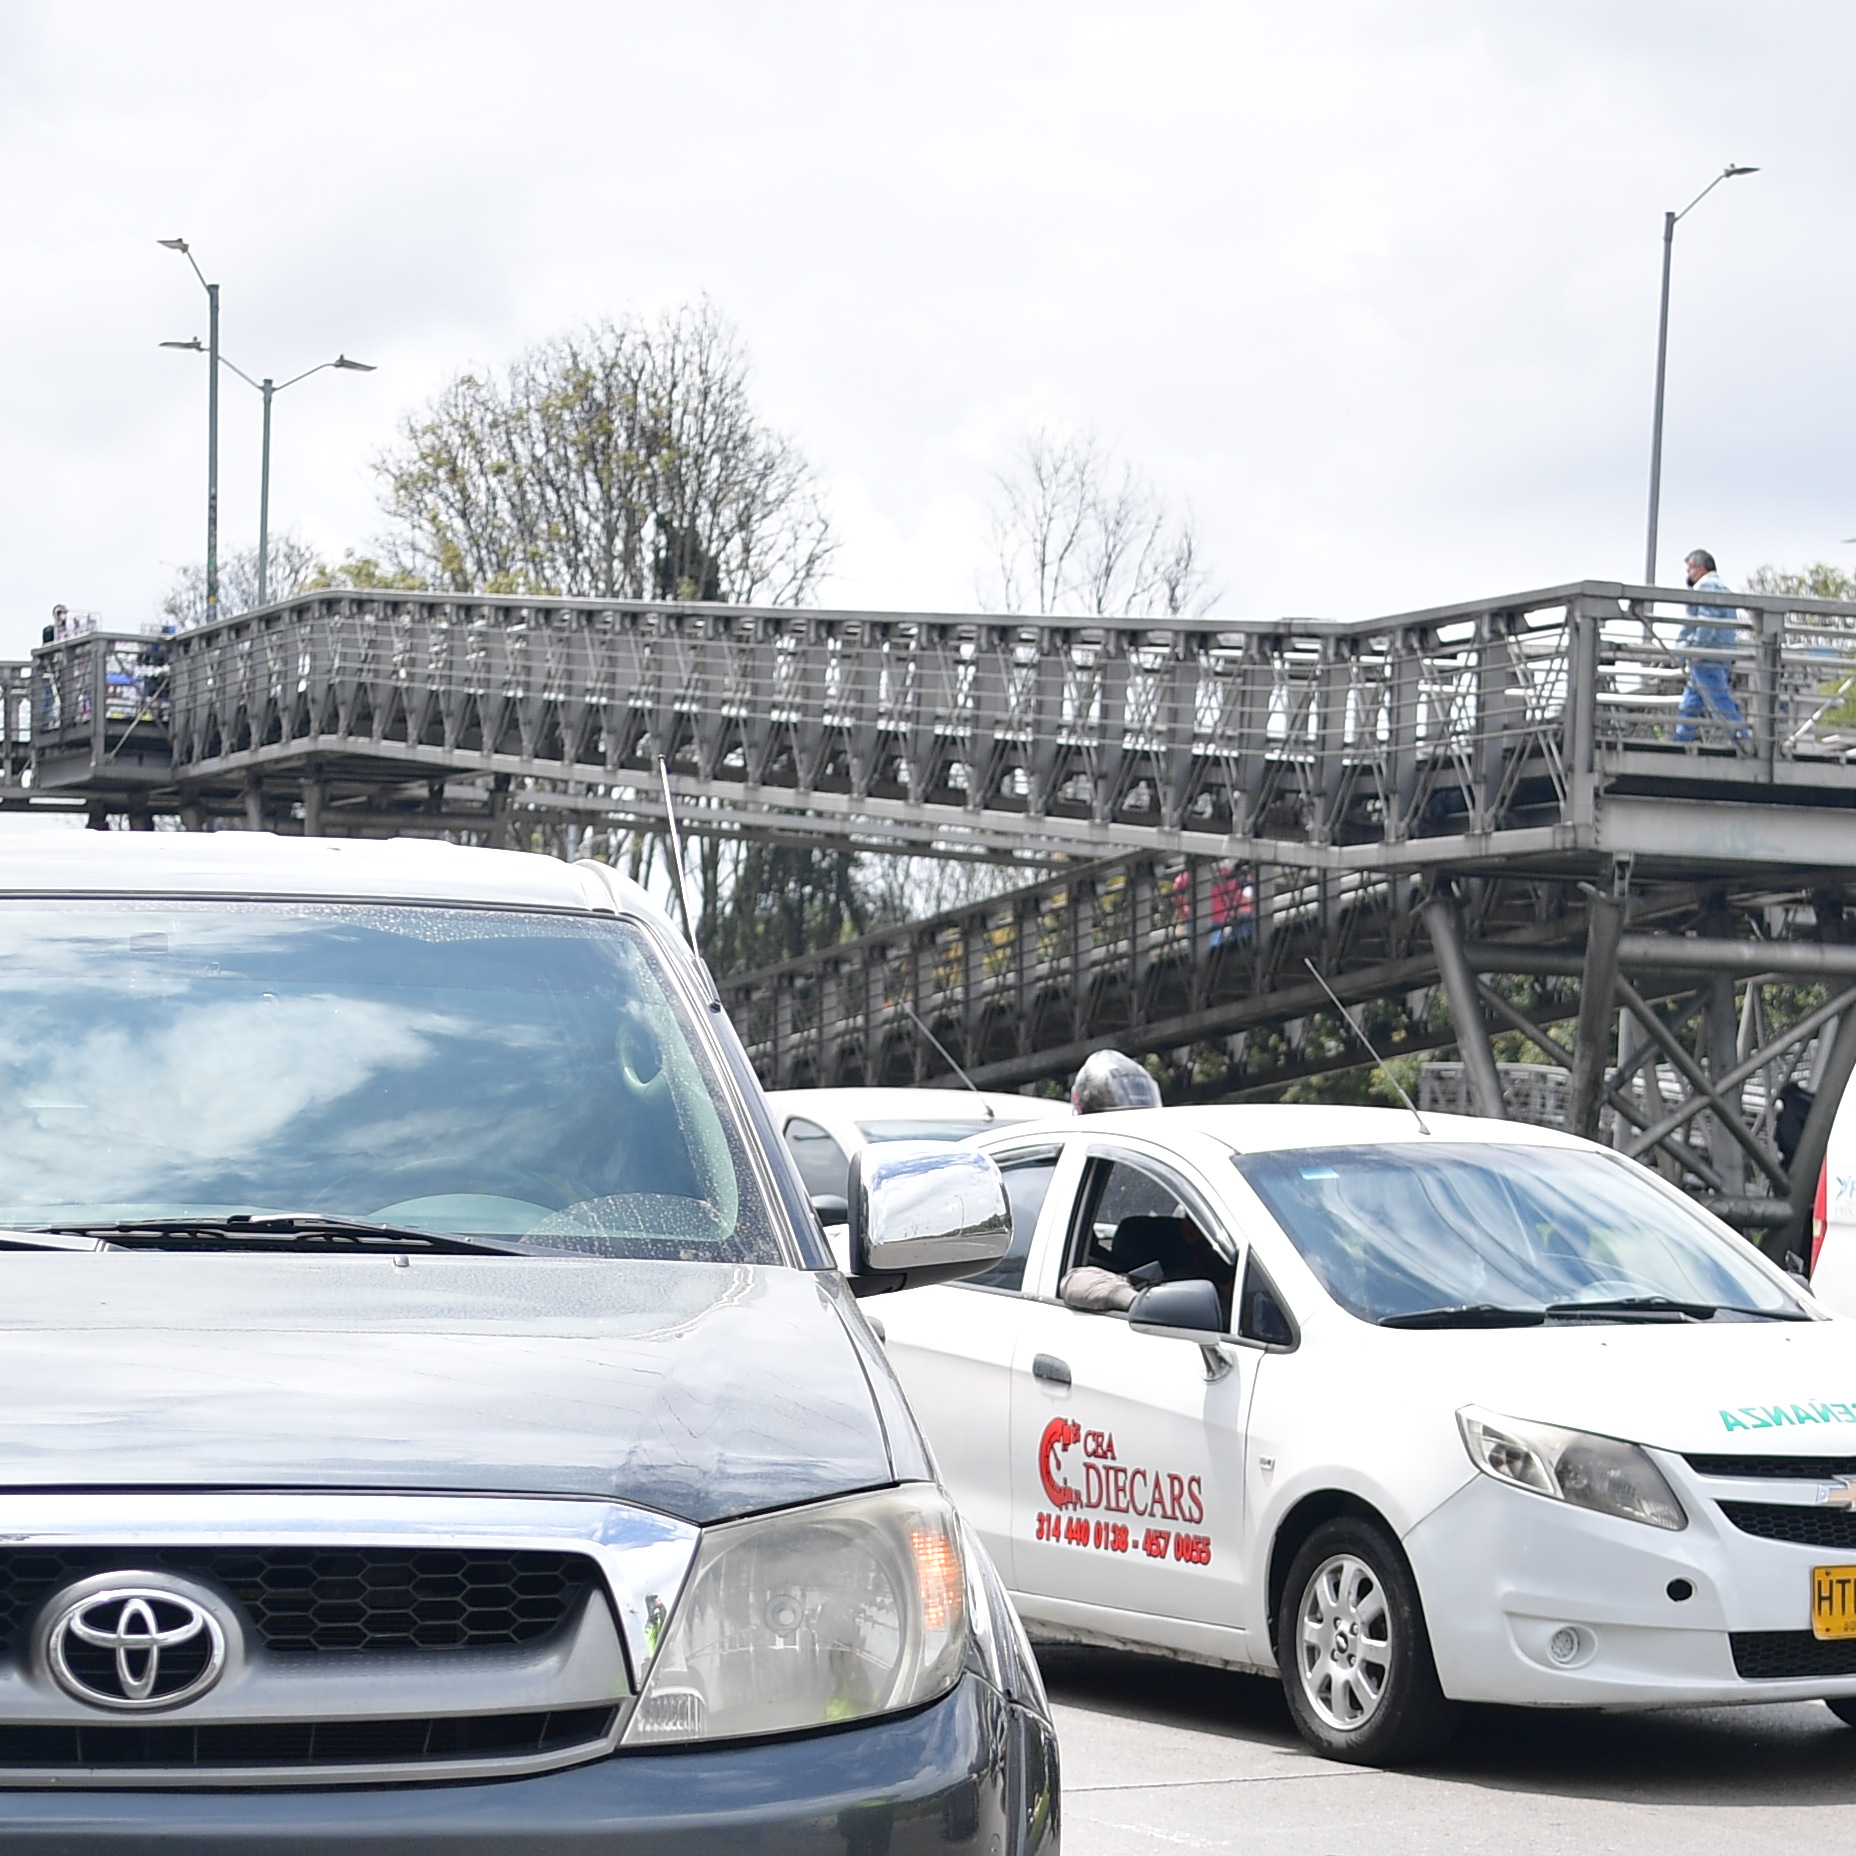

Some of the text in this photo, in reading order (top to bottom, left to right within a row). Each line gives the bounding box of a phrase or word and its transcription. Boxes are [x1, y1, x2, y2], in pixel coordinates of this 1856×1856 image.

[1083, 1430, 1117, 1460] CEA
[1083, 1462, 1204, 1524] DIECARS
[1036, 1511, 1061, 1542] 314
[1142, 1528, 1171, 1559] 457
[1174, 1532, 1211, 1566] 0055
